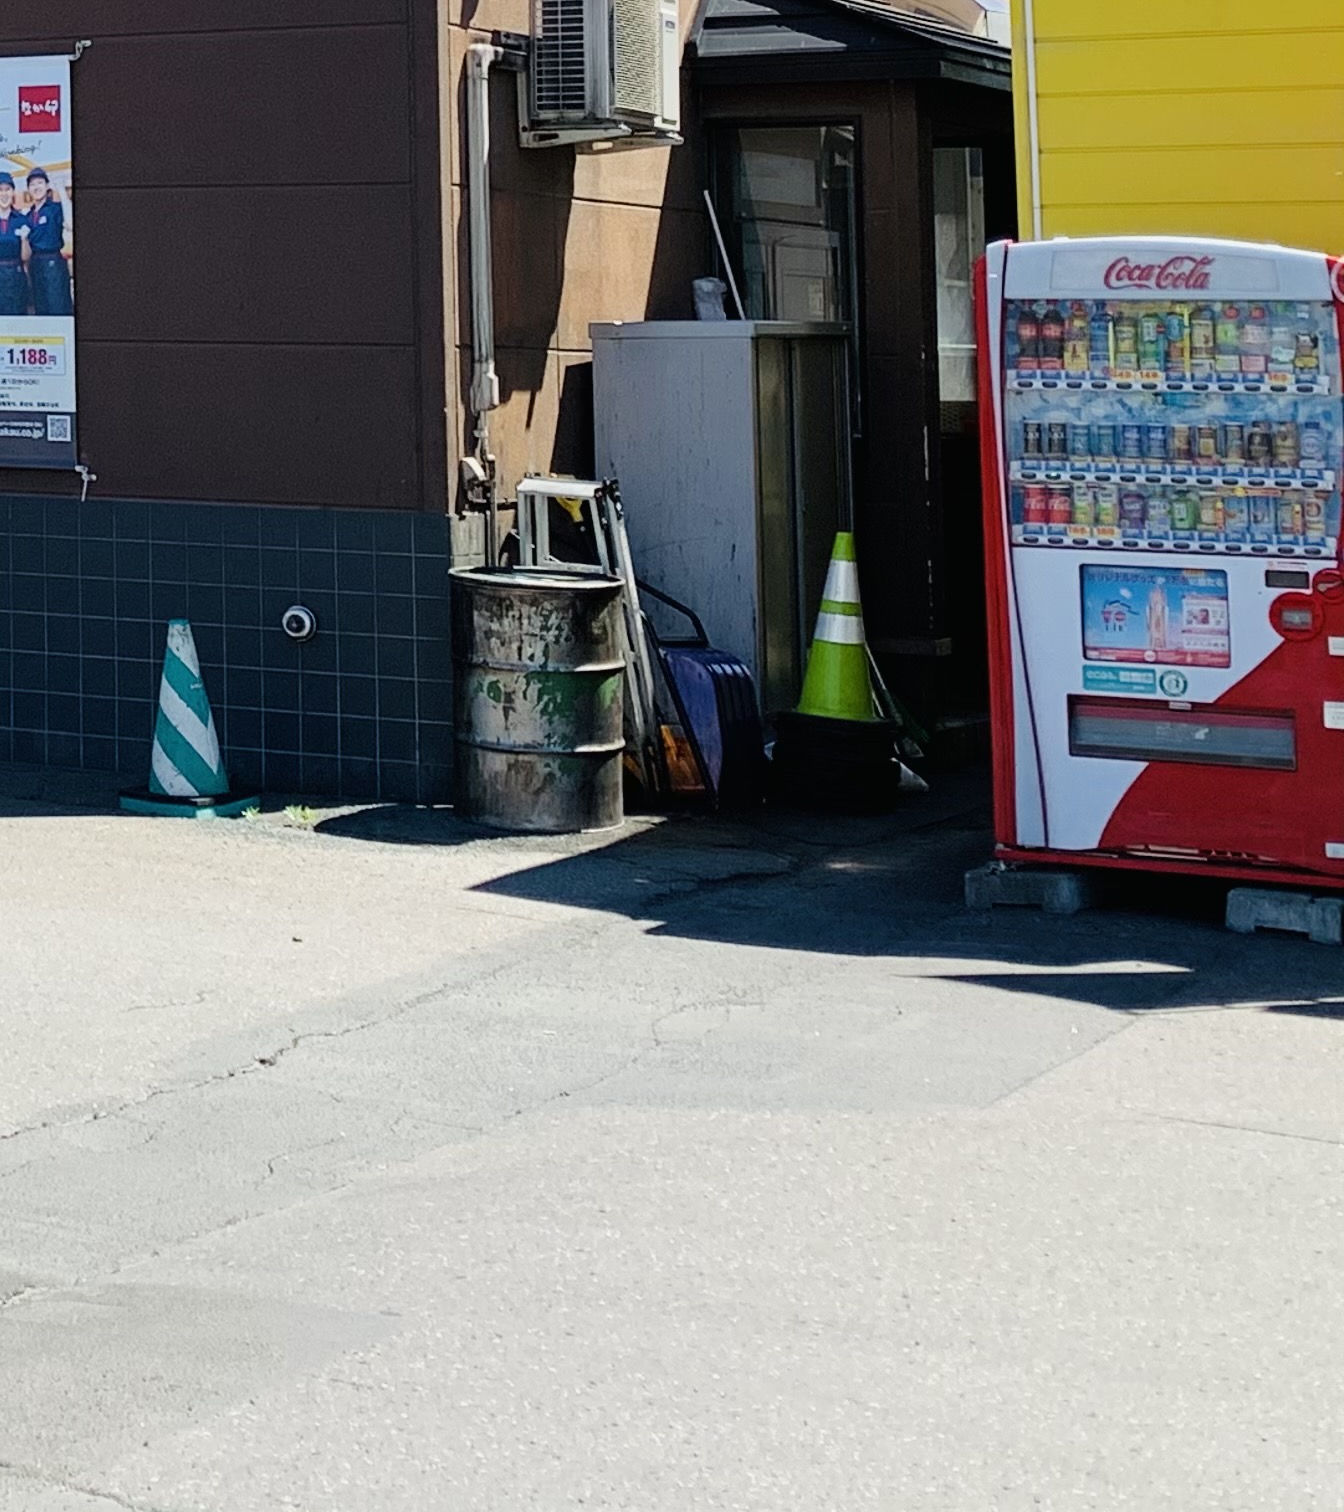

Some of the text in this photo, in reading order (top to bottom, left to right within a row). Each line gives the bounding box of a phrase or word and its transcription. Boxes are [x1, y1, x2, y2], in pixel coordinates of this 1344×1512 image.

[21, 99, 59, 117] なか卯
[1104, 255, 1216, 290] Coca-Cola
